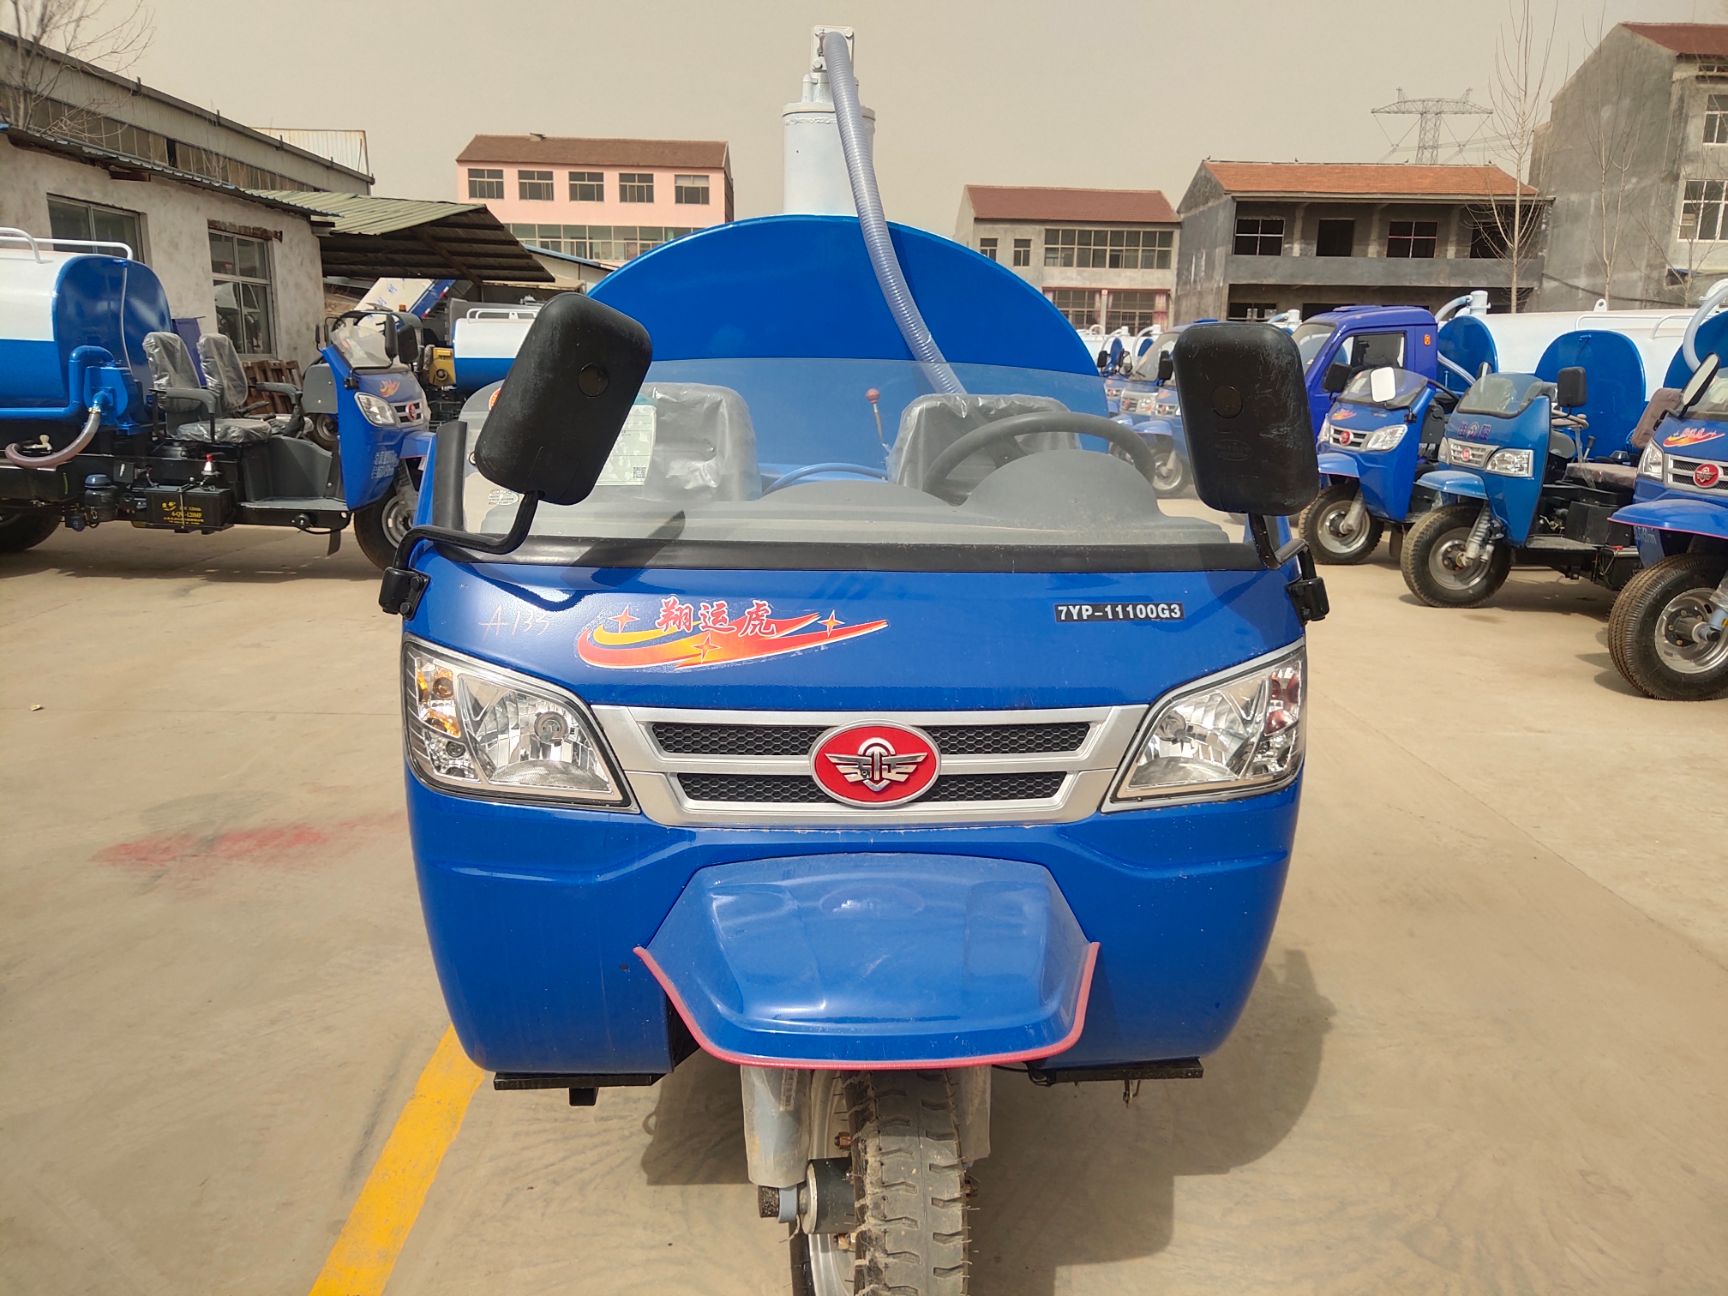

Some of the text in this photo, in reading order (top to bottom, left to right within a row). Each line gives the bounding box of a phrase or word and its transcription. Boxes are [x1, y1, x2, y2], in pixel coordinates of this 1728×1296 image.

[655, 595, 777, 638] 翔运虎
[1057, 603, 1182, 620] 7YP-11100G3
